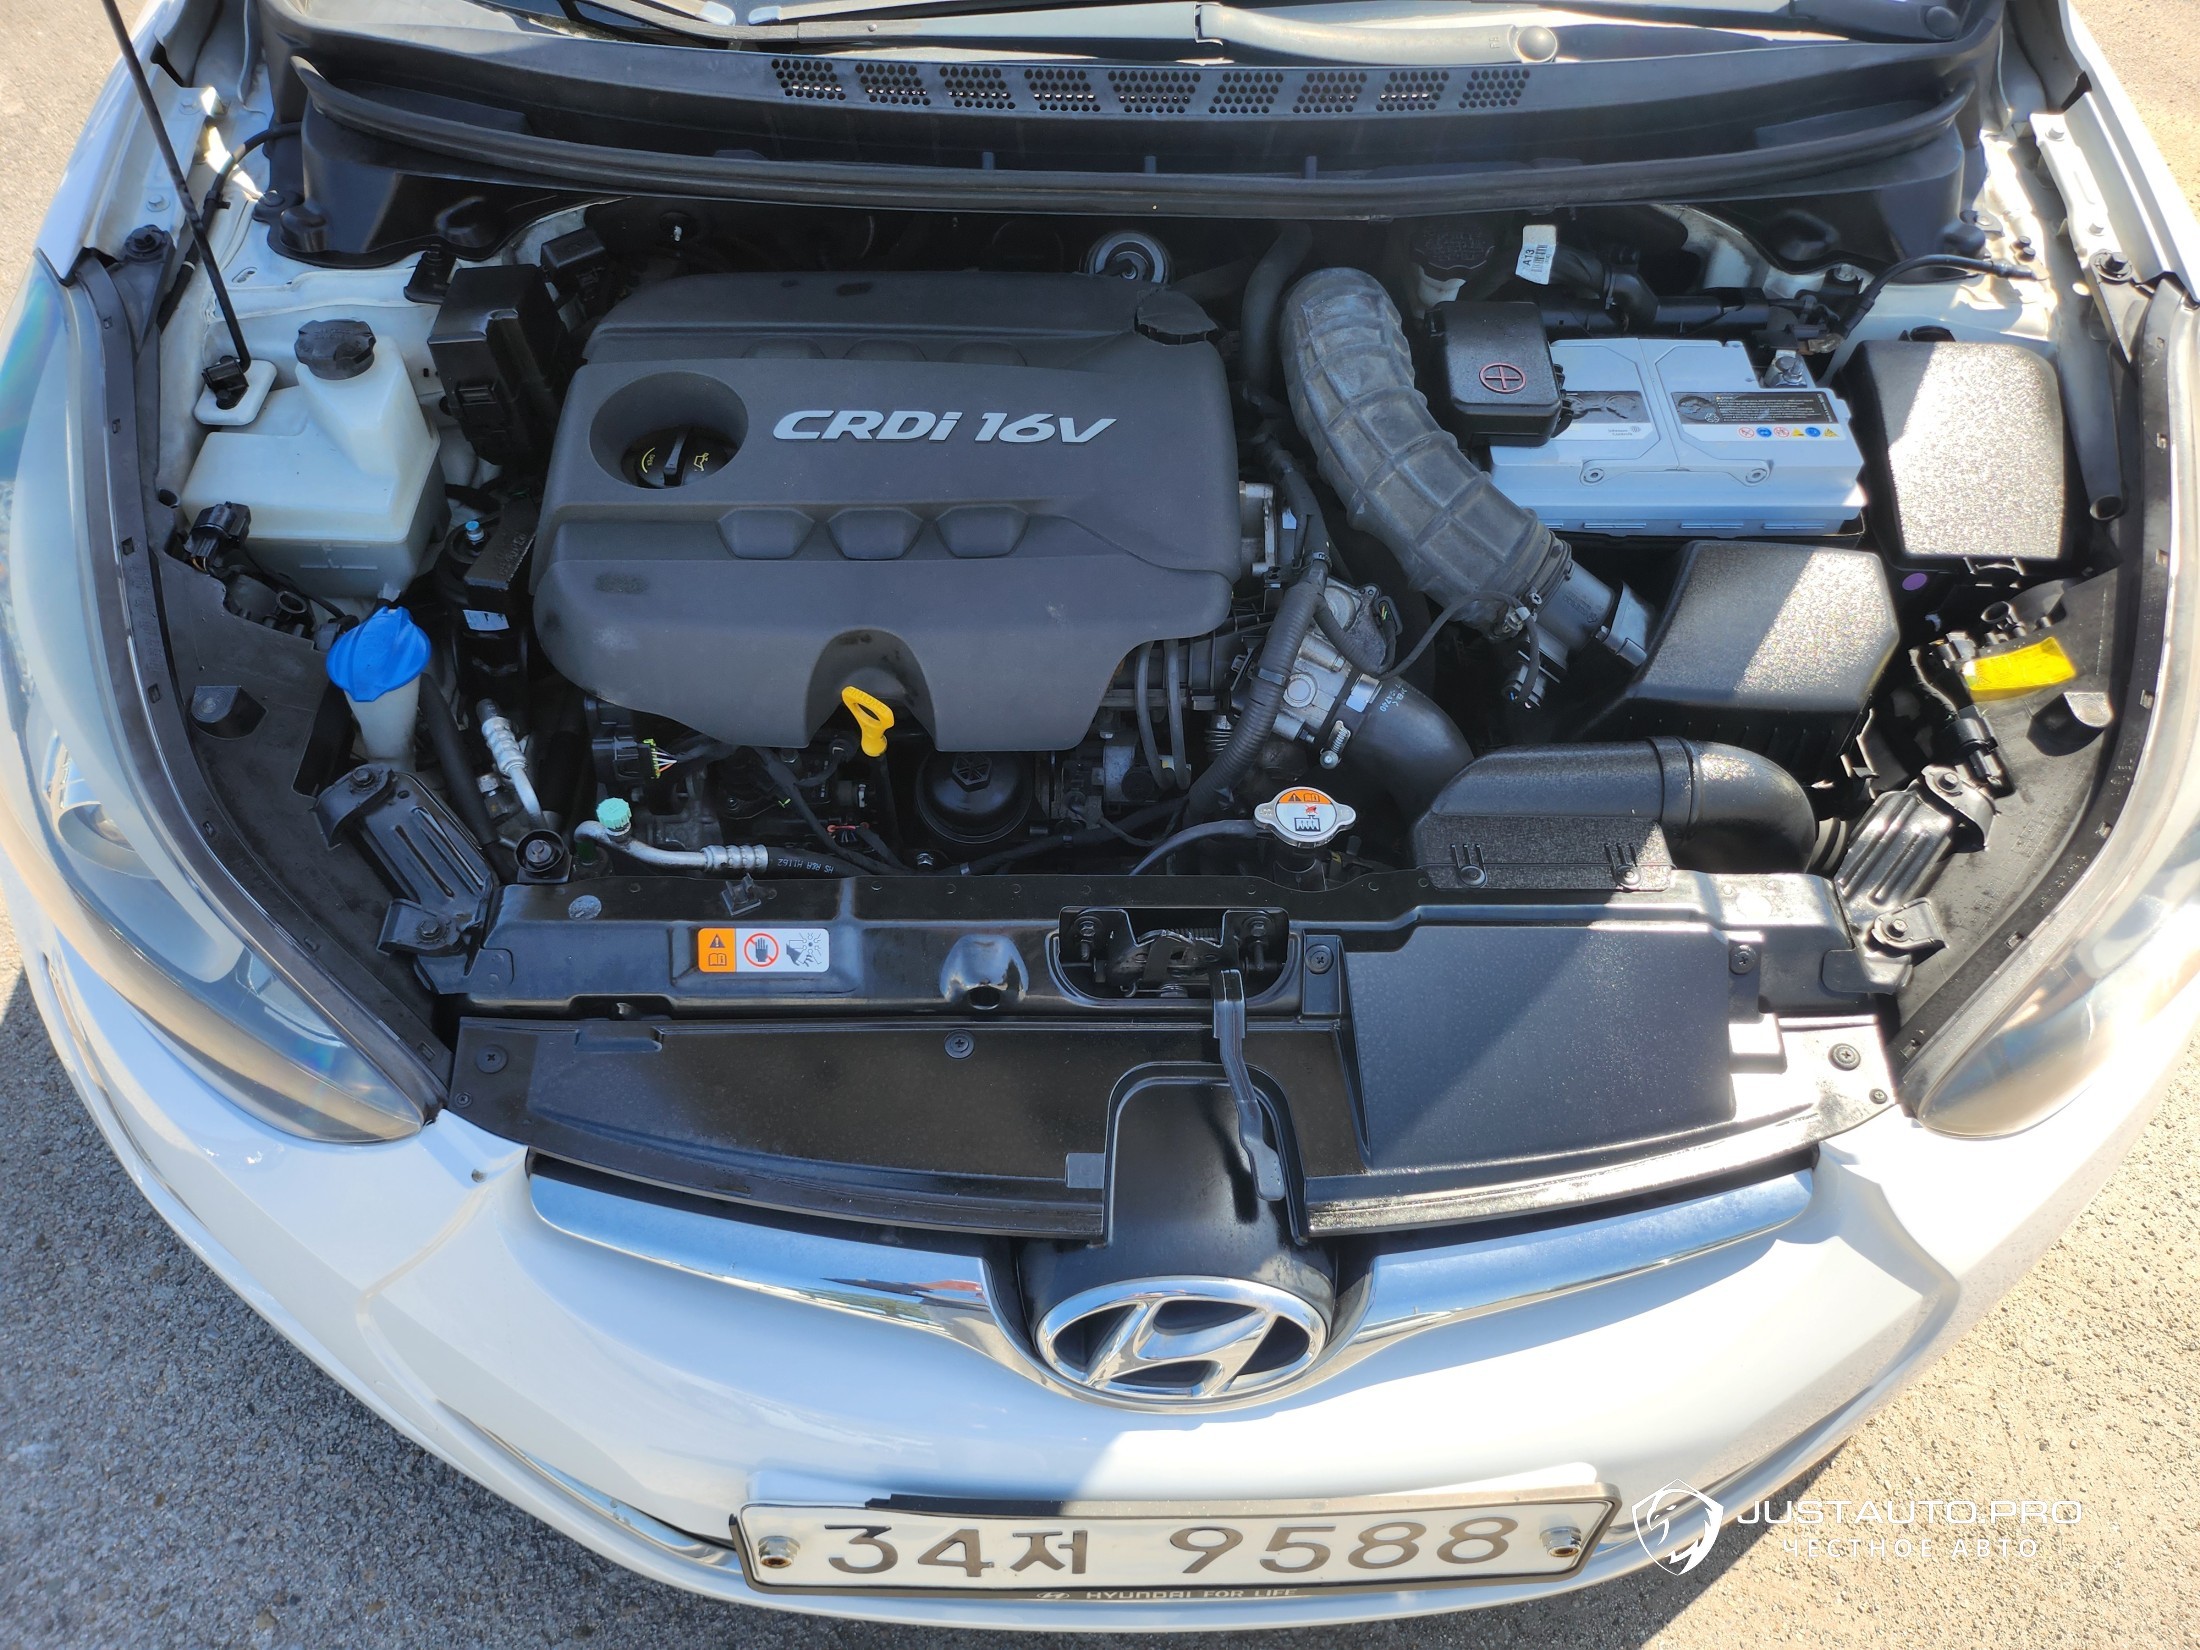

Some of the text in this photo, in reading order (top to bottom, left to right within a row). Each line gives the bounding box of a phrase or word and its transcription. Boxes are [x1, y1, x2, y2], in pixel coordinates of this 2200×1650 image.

[1523, 249, 1535, 266] A13
[772, 410, 1117, 443] CRDi 16V
[824, 1516, 1519, 1577] 34저 9588
[1086, 1588, 1297, 1600] HYUNDAI FOR LIFE
